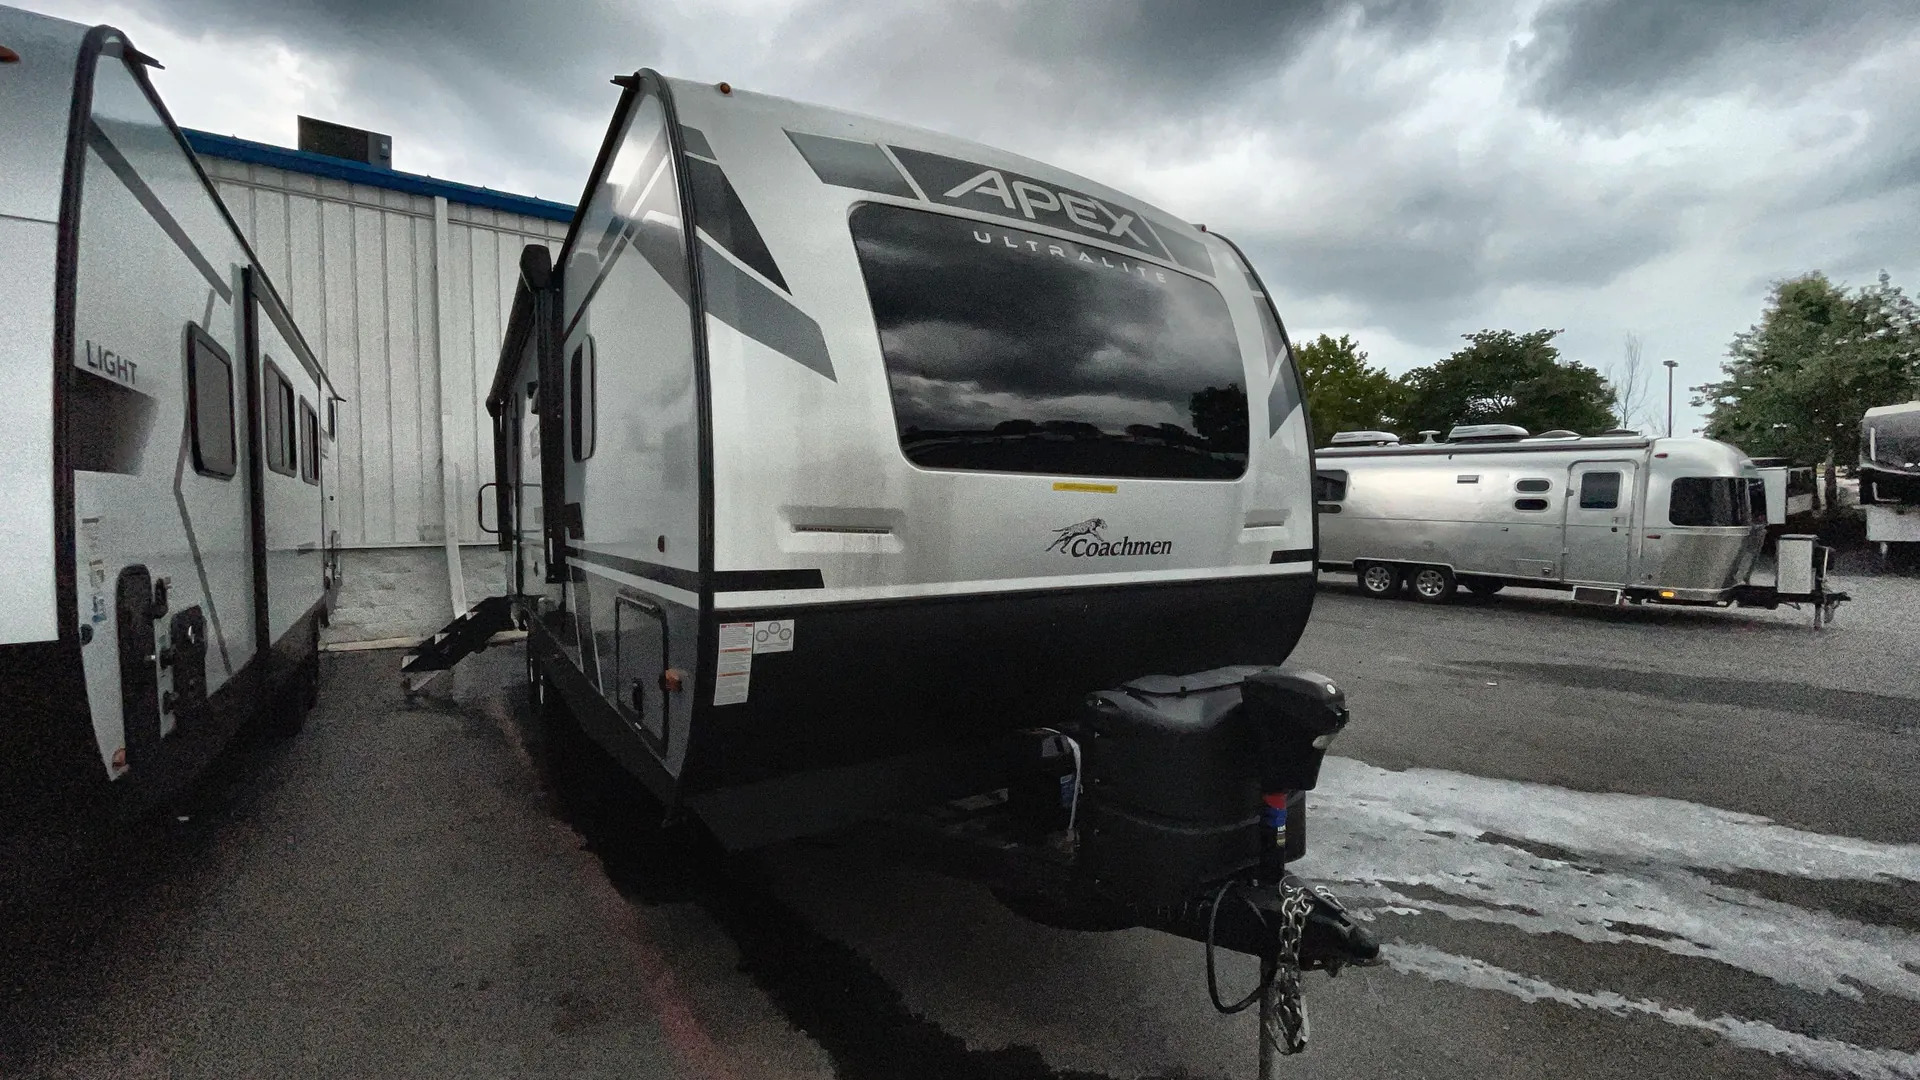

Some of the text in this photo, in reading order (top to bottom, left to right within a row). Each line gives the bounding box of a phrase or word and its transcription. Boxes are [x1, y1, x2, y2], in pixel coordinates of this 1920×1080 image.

[943, 170, 1149, 248] APEX
[973, 230, 1167, 284] ULTRALITE
[86, 339, 137, 385] LIGHT
[1071, 536, 1173, 558] Coachmen
